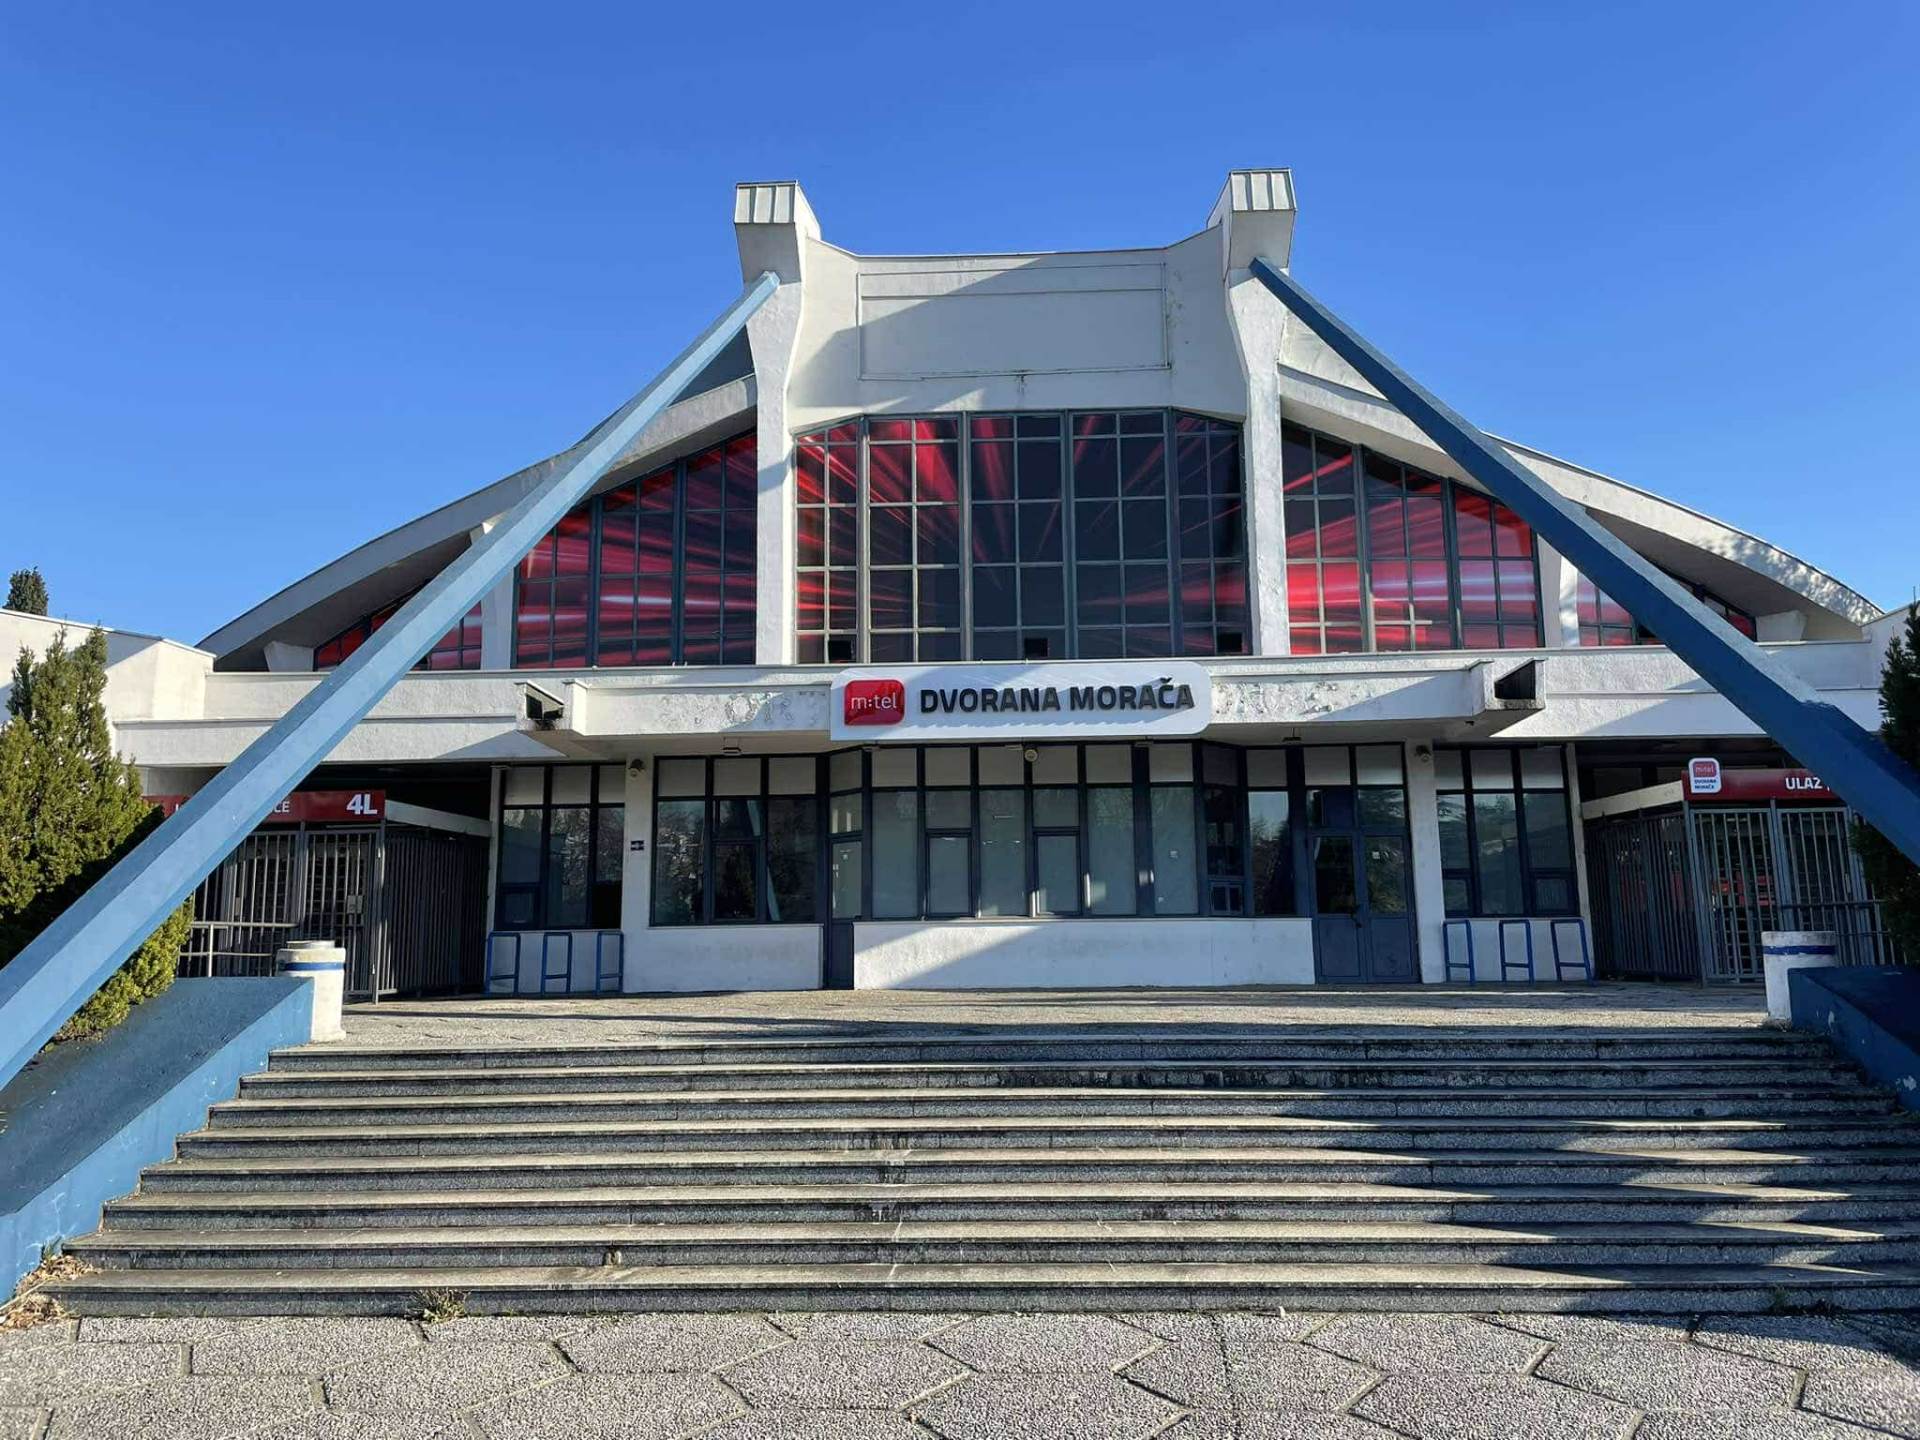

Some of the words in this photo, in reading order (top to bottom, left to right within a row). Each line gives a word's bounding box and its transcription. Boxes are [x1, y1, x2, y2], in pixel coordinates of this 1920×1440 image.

[850, 691, 897, 710] m:tel
[920, 687, 1062, 714] DVORANA
[1070, 677, 1196, 711] MORAČA
[346, 793, 378, 815] 4L
